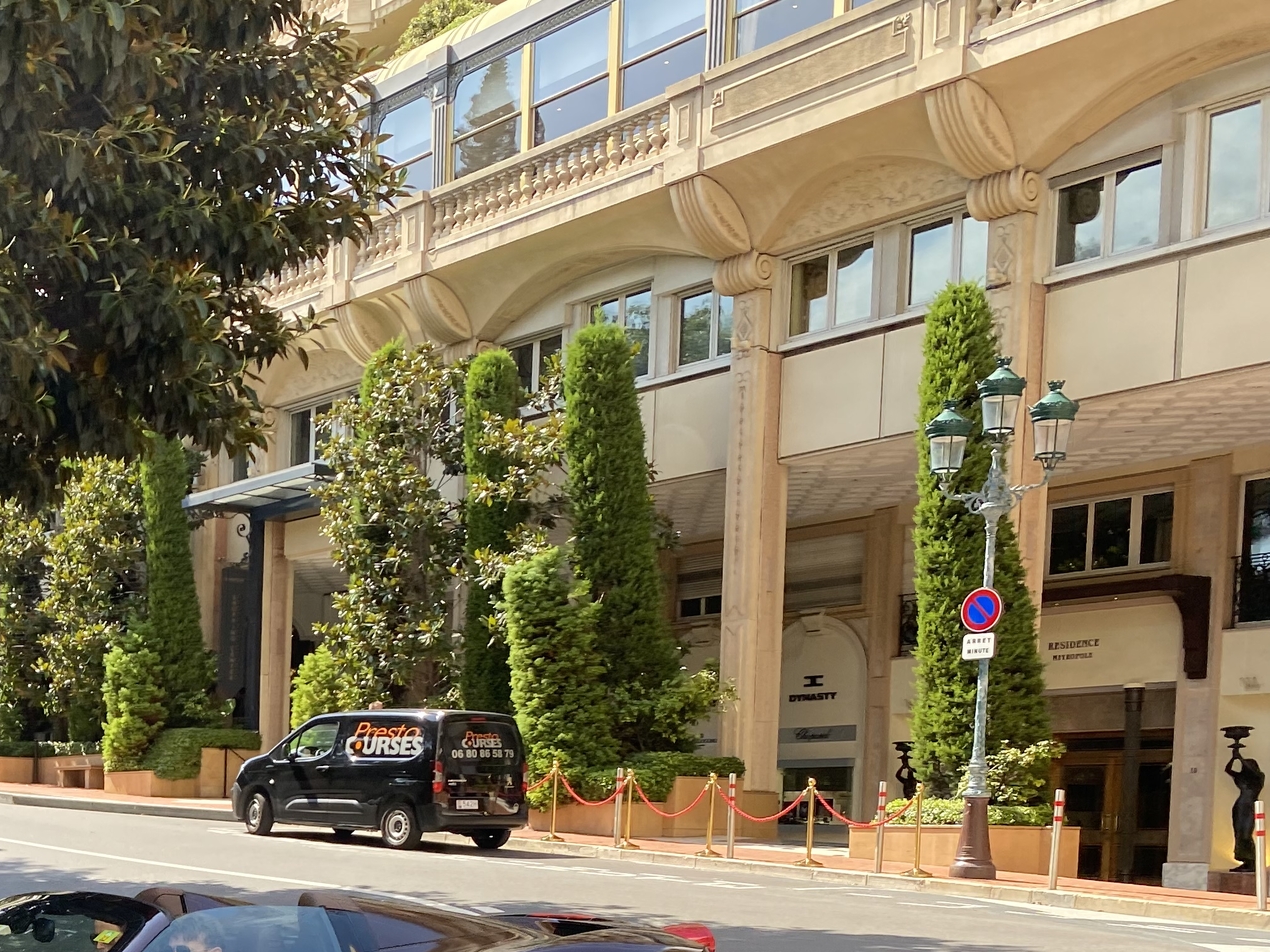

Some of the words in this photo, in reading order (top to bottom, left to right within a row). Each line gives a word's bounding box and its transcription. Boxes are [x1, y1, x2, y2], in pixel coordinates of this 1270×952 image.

[1048, 639, 1100, 650] RESIDENCE
[789, 692, 837, 702] DYNASTY
[354, 722, 421, 738] Presto
[465, 731, 499, 740] Presto
[452, 749, 464, 758] 06
[466, 749, 477, 758] 80
[504, 749, 515, 758] 79
